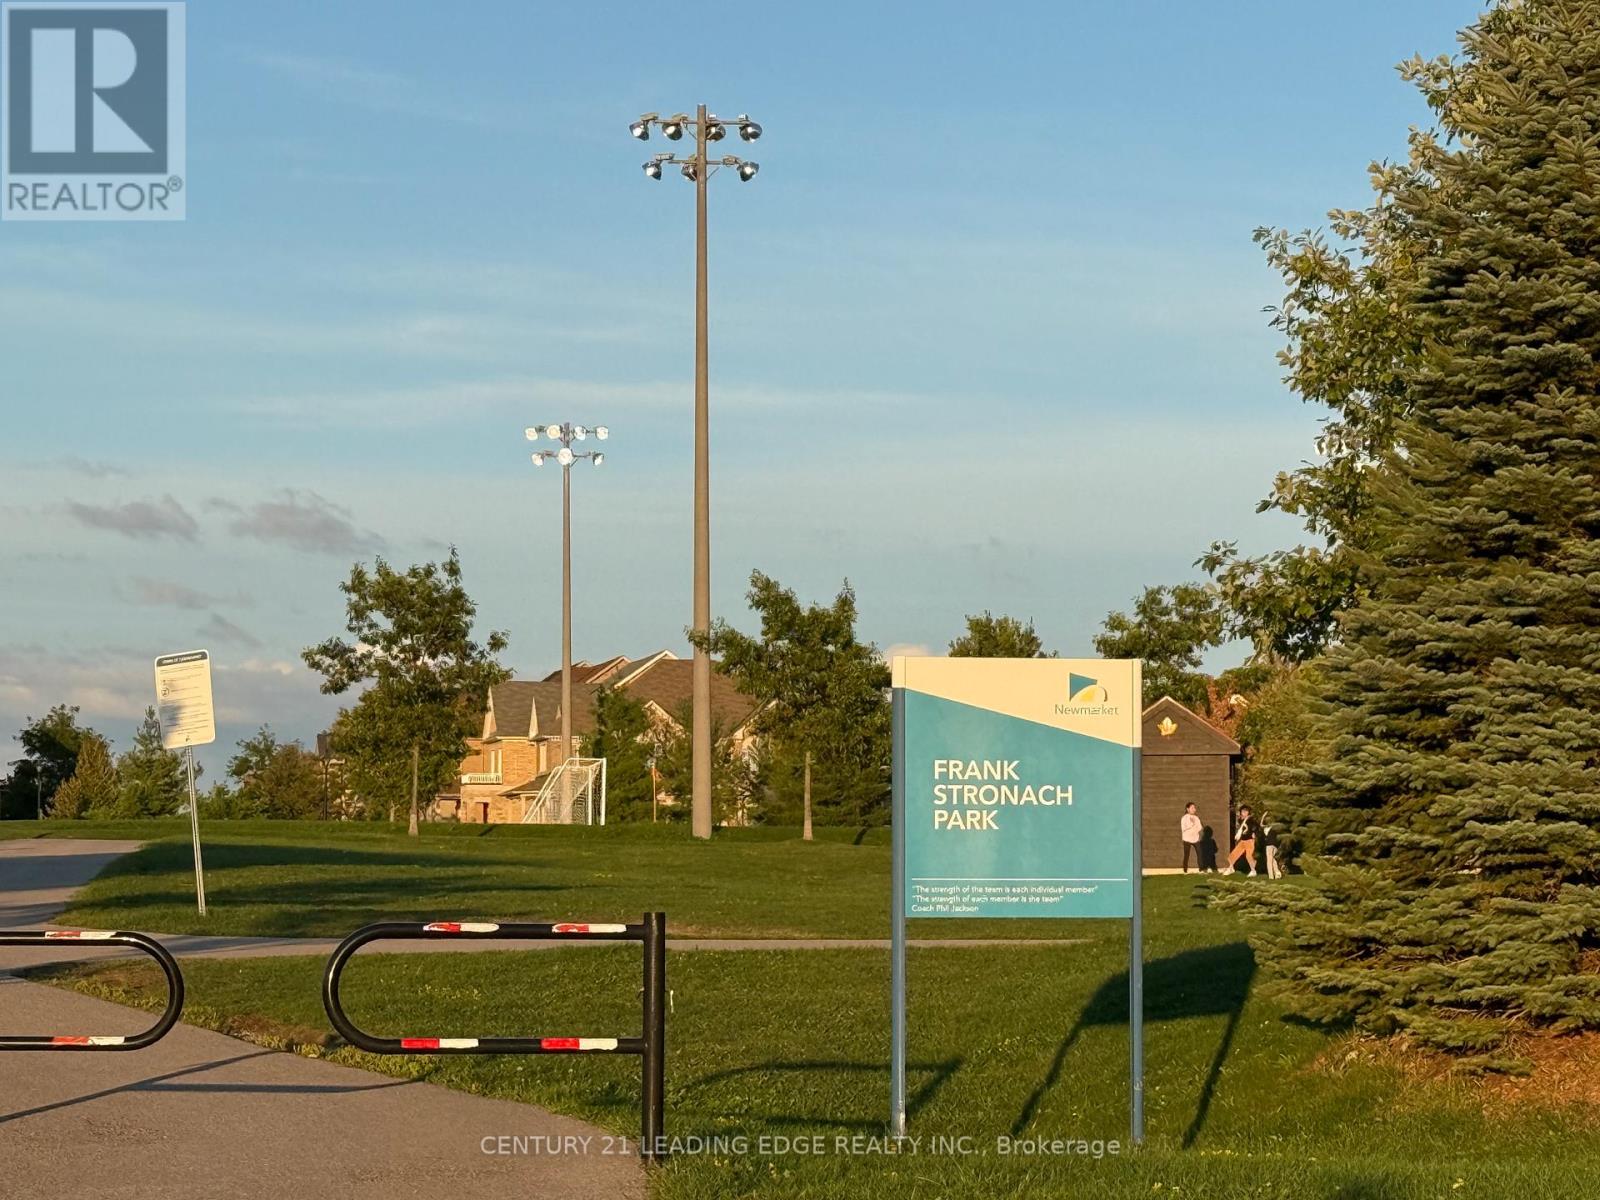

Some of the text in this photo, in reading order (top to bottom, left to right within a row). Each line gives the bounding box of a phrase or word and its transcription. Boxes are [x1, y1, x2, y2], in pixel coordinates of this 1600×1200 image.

[1054, 703, 1120, 716] Newmarket
[934, 759, 1020, 781] FRANK
[933, 784, 1073, 806] STRONACH
[934, 809, 999, 831] PARK
[931, 885, 961, 895] strength
[962, 885, 970, 894] of
[971, 885, 984, 894] the
[985, 886, 1003, 894] team
[1012, 886, 1029, 894] each
[1030, 885, 1064, 894] individual
[962, 895, 971, 903] of
[911, 904, 980, 913] Coach Phil Jackson
